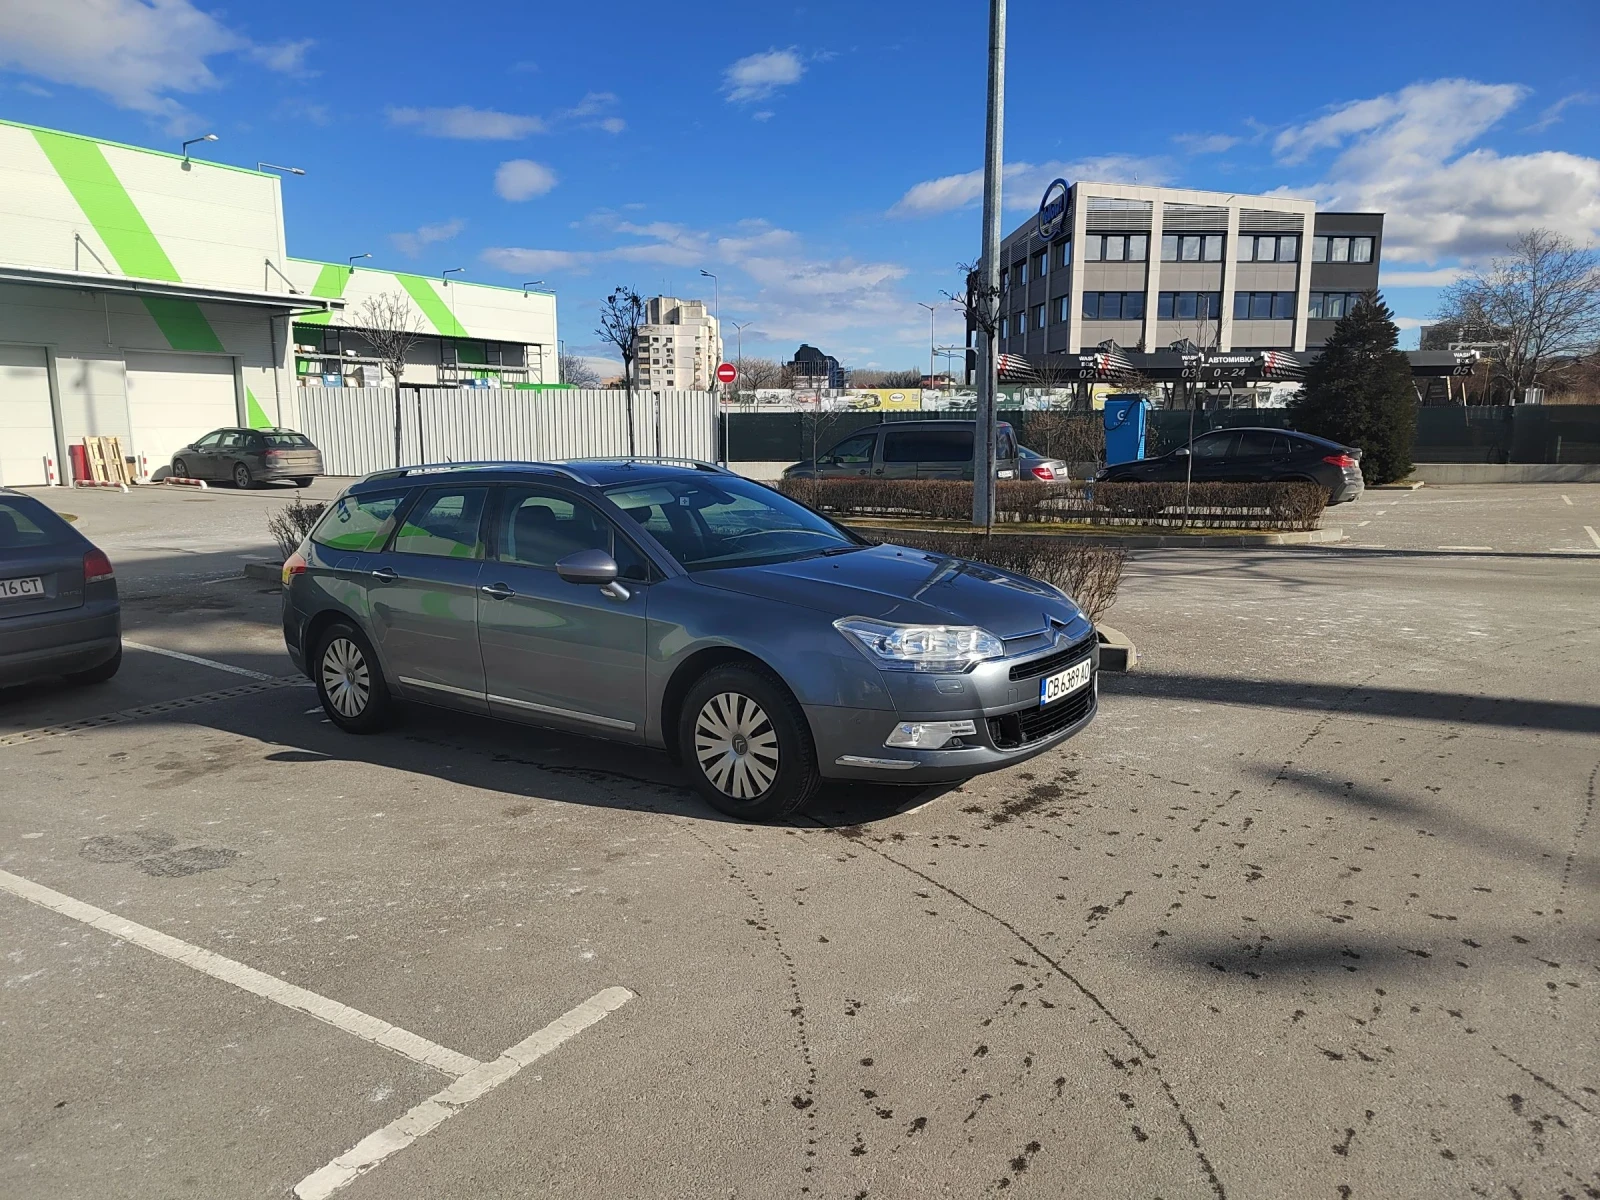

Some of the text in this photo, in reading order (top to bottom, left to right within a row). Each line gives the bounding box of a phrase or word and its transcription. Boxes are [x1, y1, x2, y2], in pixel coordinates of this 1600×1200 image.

[1079, 369, 1094, 379] 02
[1181, 368, 1196, 378] 03
[1213, 368, 1221, 377] 0
[1230, 368, 1246, 377] 24
[1452, 366, 1470, 375] 05
[20, 579, 39, 593] CT
